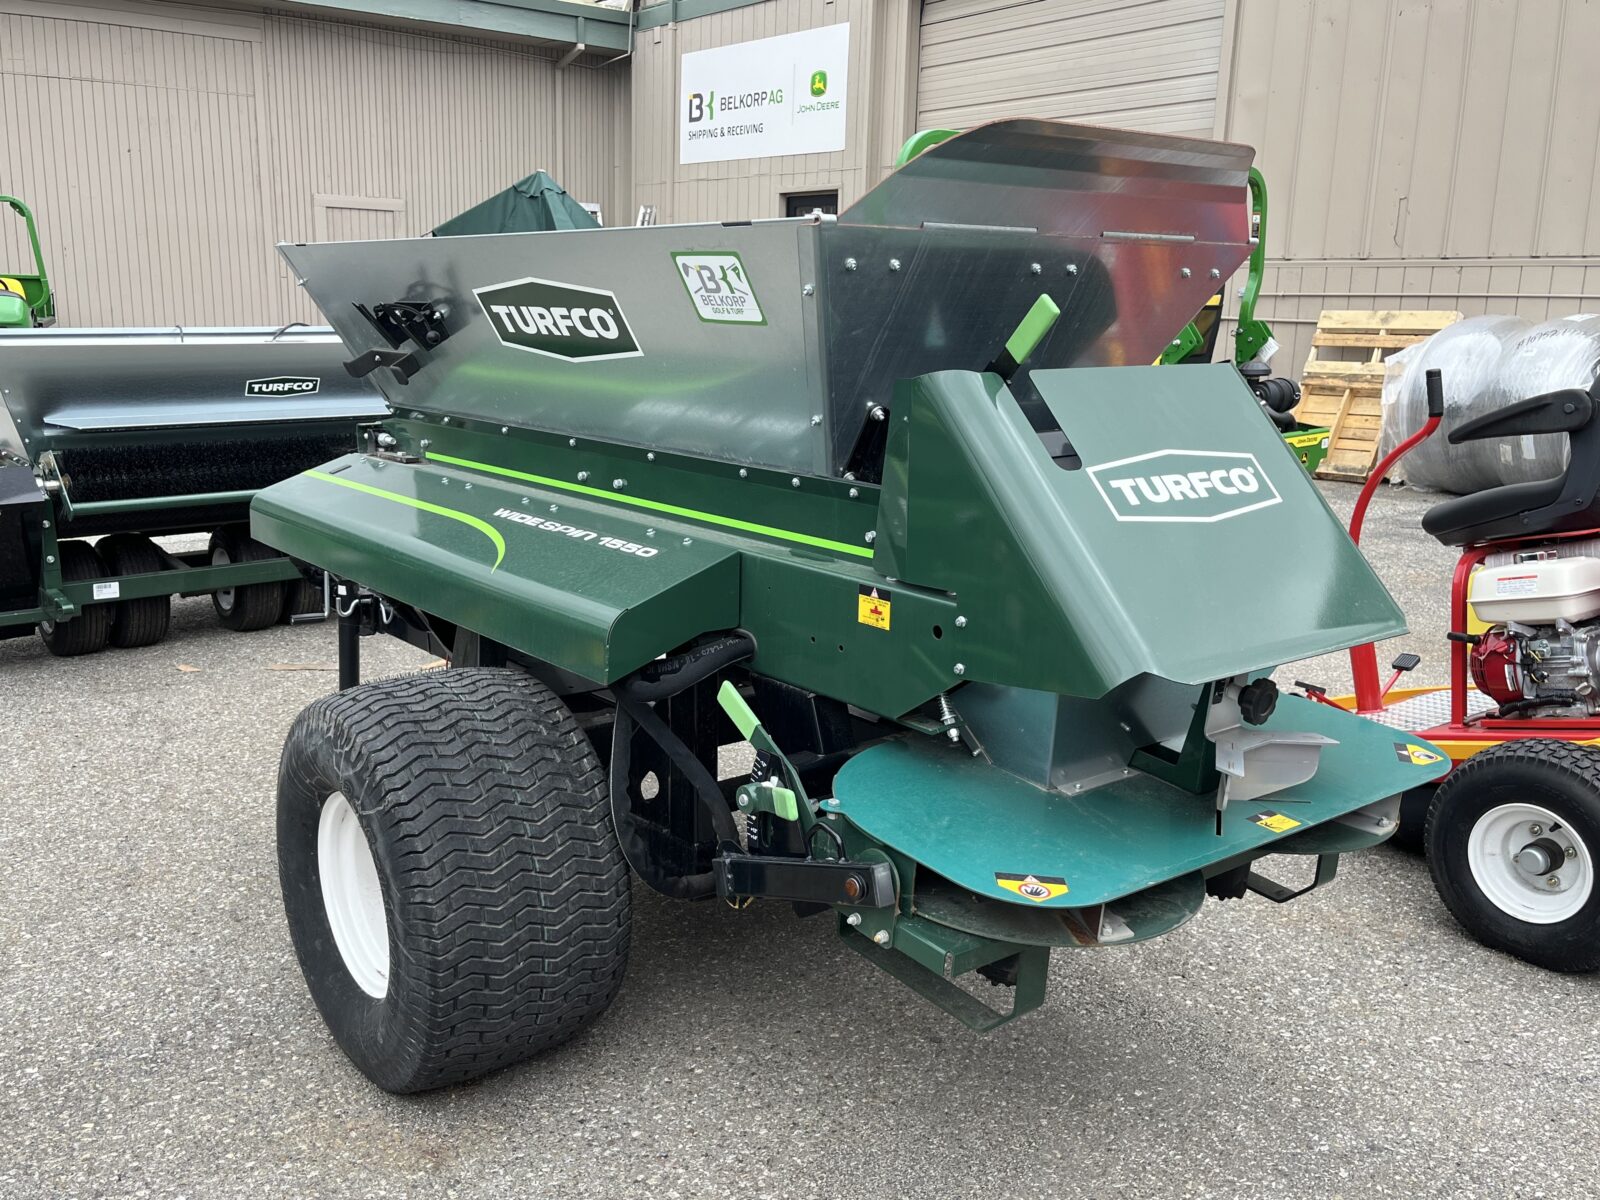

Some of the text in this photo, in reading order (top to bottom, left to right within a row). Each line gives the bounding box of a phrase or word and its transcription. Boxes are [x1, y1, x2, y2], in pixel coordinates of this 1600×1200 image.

[797, 101, 840, 114] JOHN DEERE
[688, 123, 764, 141] SHIPPING & RECEIVING
[700, 294, 746, 307] BELKORP
[598, 536, 659, 558] 1550
